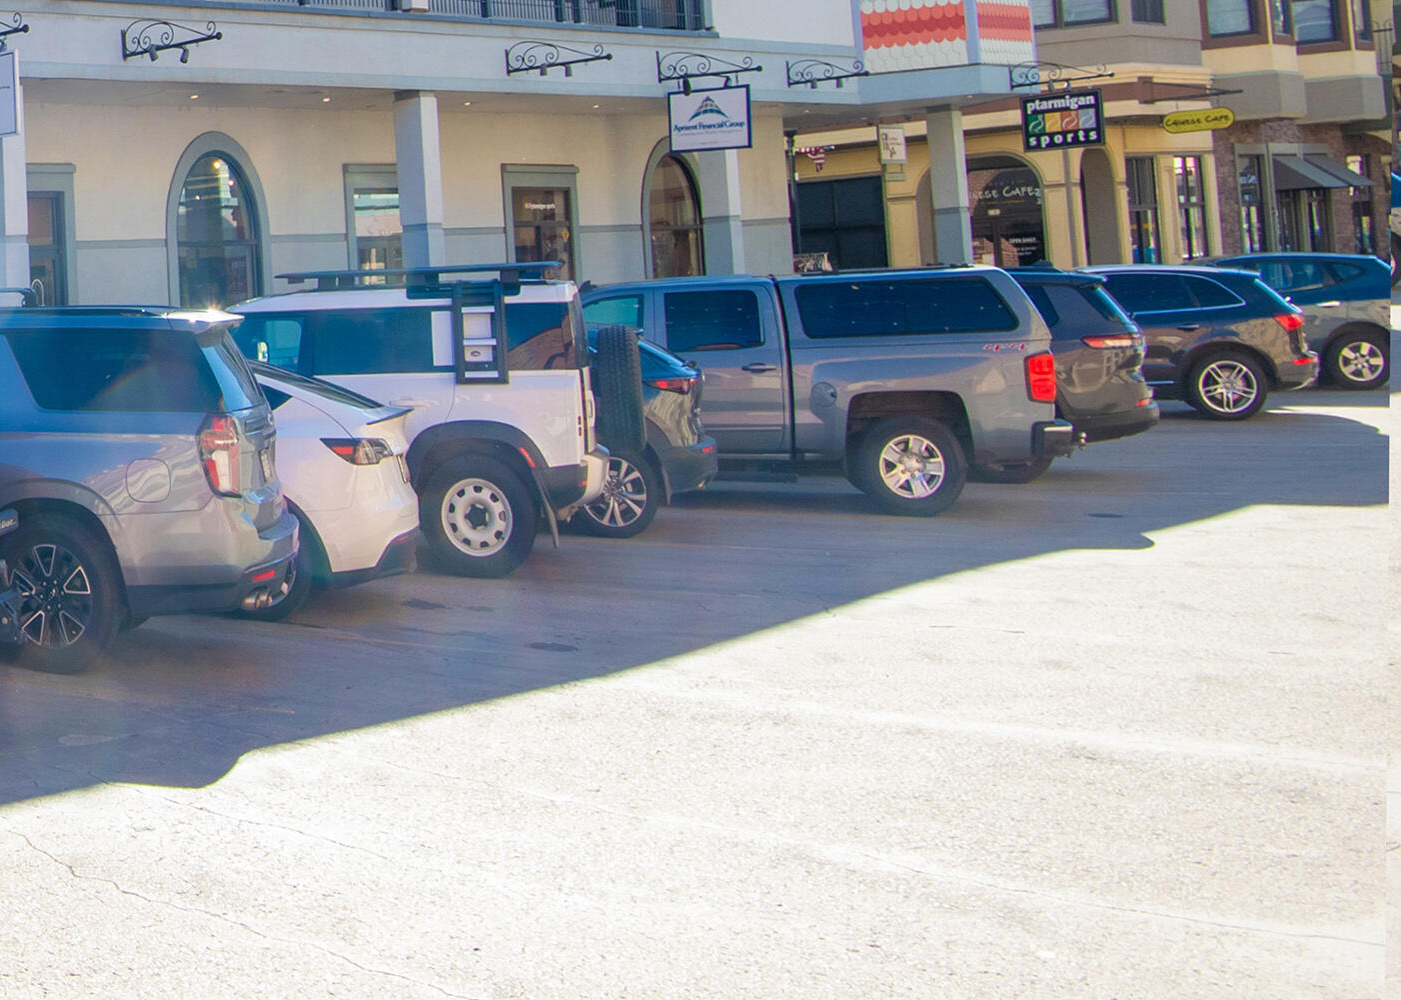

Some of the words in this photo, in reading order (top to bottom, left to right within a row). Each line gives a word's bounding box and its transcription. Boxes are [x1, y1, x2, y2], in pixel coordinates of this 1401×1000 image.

[1027, 95, 1096, 114] ptarmigan
[726, 120, 745, 128] Group
[1029, 130, 1098, 148] sports
[1002, 185, 1035, 198] CAFE
